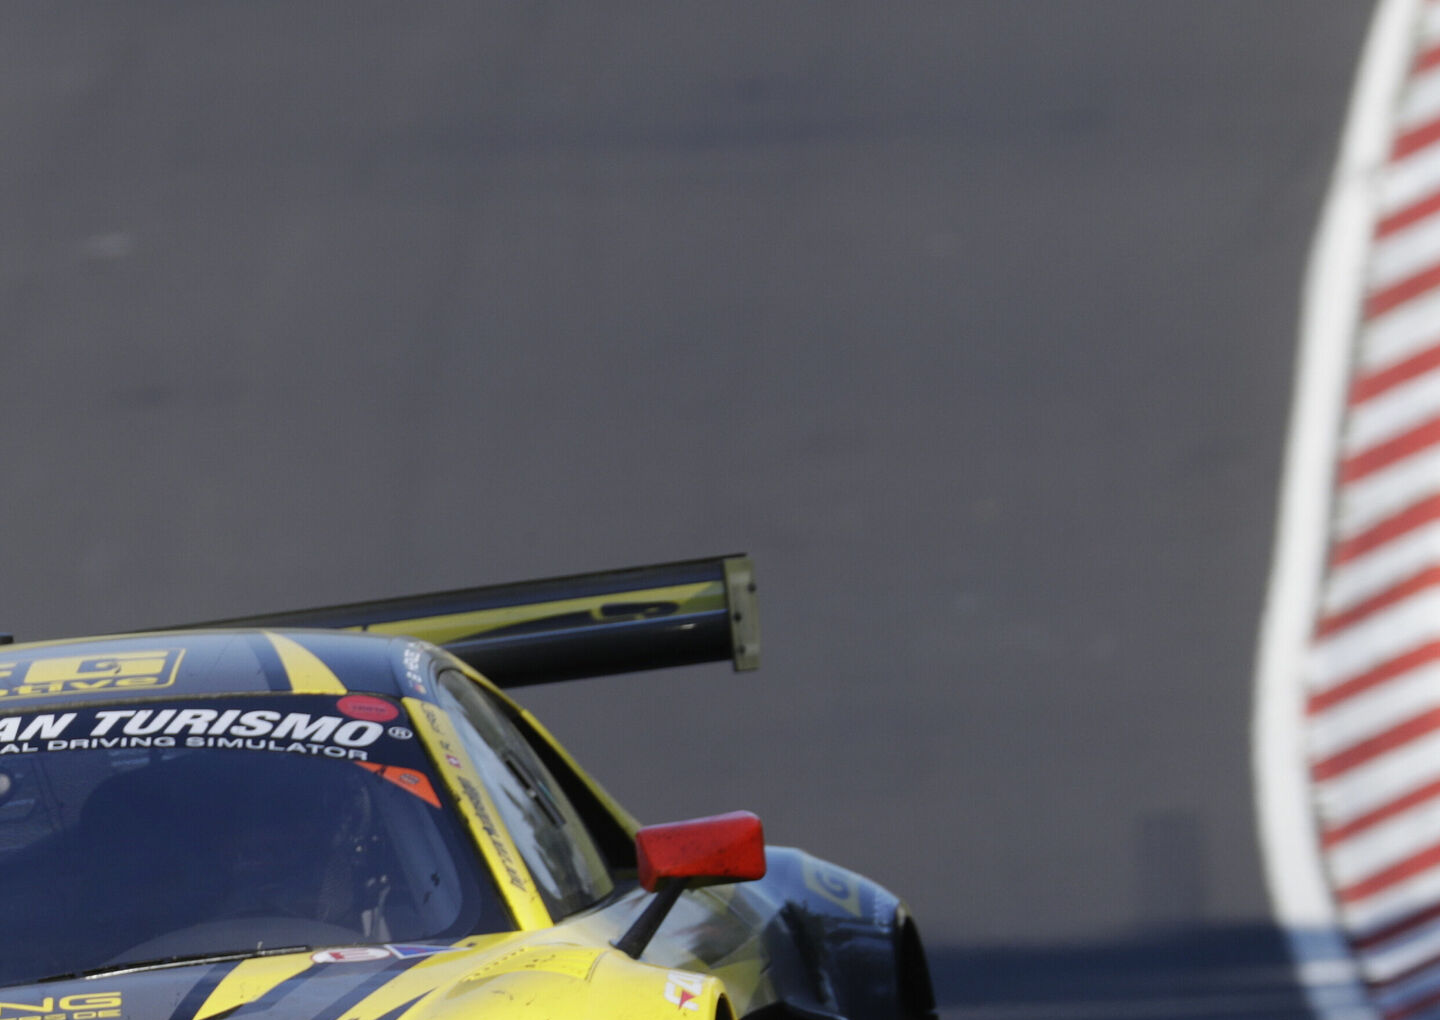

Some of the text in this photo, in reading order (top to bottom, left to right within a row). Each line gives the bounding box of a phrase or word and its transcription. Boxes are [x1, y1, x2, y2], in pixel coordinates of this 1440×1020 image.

[90, 709, 384, 747] TURISMO
[47, 735, 176, 751] DRIVING
[185, 736, 368, 761] SIMULATOR
